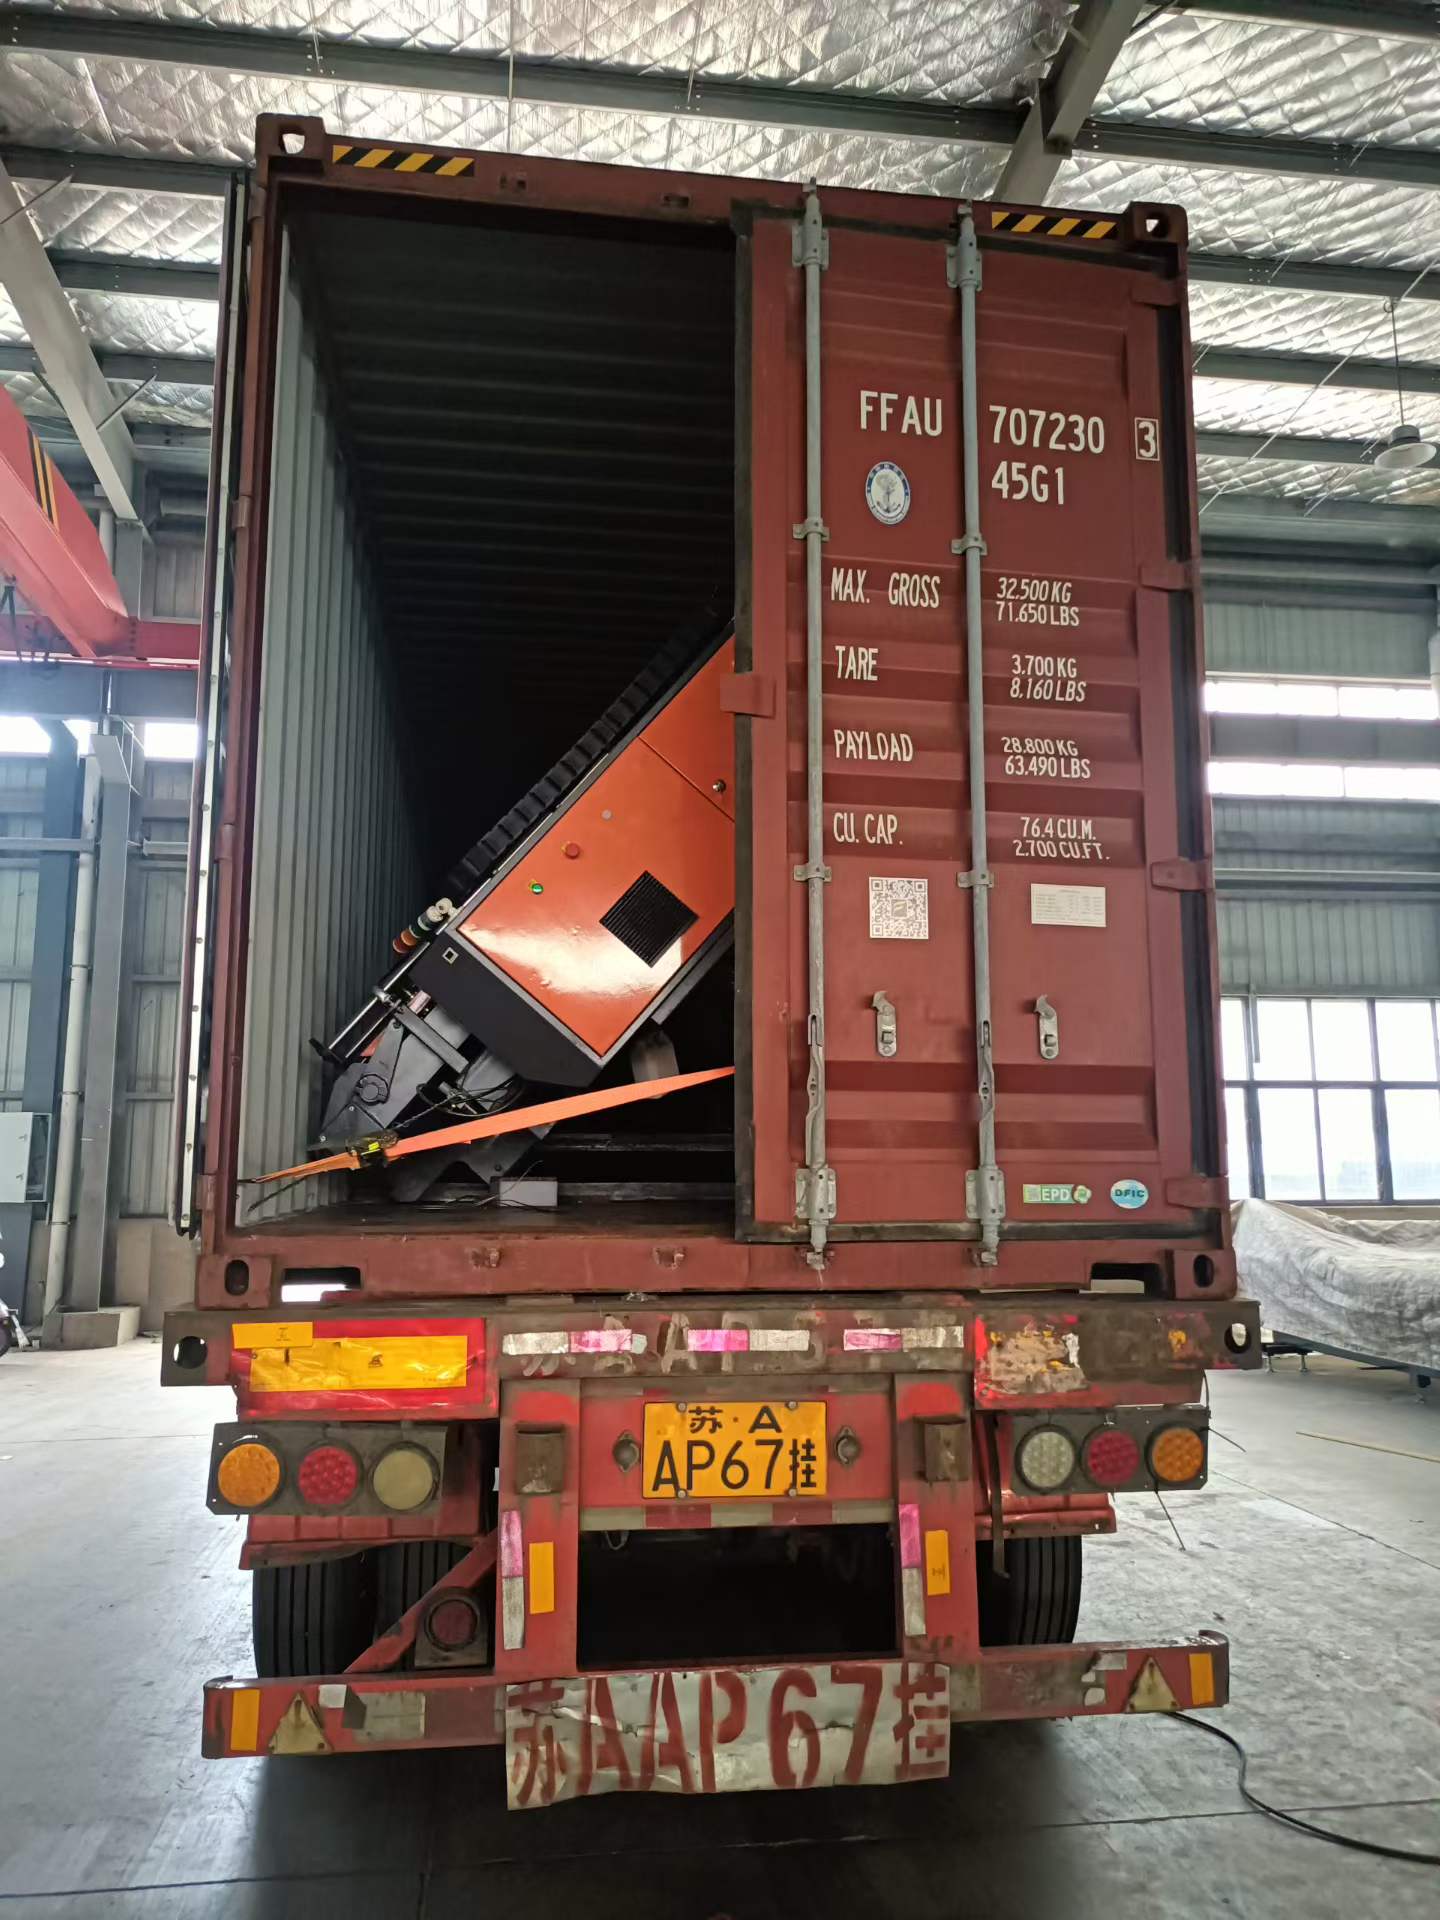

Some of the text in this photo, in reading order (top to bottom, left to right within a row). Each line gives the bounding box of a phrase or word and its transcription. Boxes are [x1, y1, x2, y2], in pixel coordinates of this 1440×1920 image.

[860, 390, 1157, 458] FFAU 707230 3
[991, 460, 1065, 505] 45G1
[831, 567, 870, 604] MAX.
[888, 572, 941, 608] GROSS
[835, 645, 879, 681] TARE
[833, 729, 914, 762] PAYLOAD
[833, 812, 860, 843] CU.
[864, 813, 904, 845] CAP.
[1020, 816, 1054, 838] 76.4
[1114, 1188, 1146, 1198] DFIC
[652, 1437, 817, 1493] AP67挂
